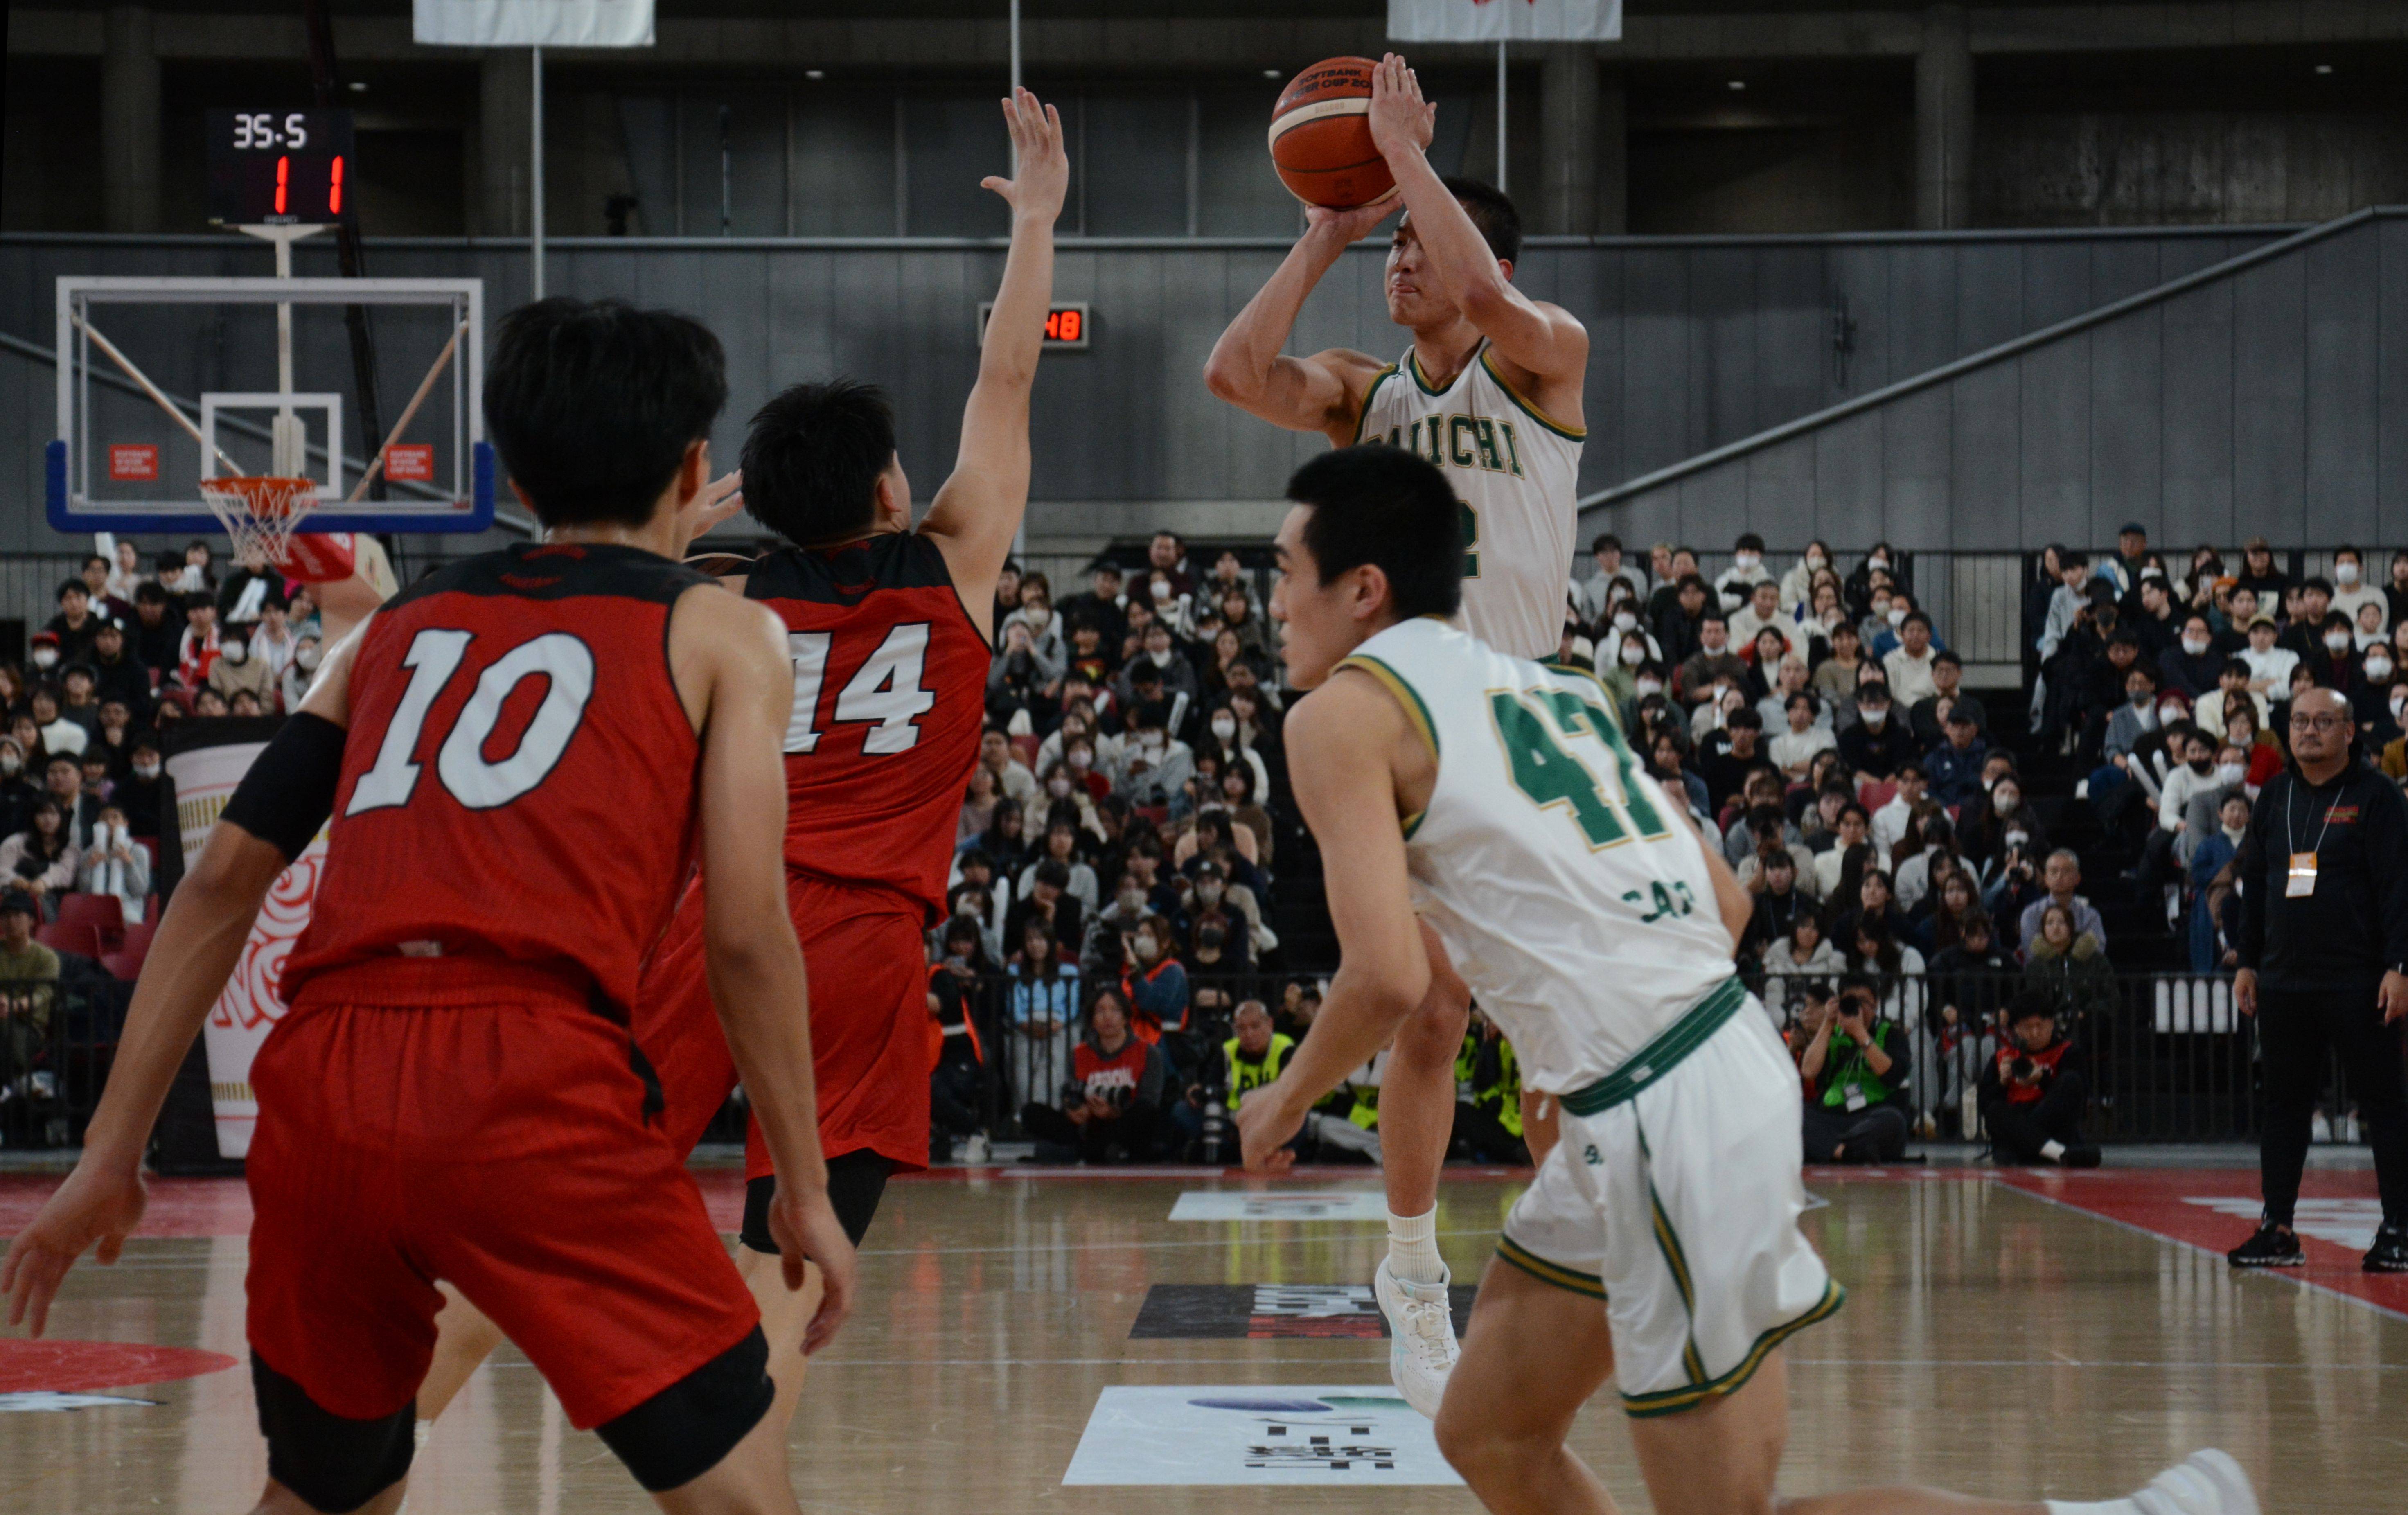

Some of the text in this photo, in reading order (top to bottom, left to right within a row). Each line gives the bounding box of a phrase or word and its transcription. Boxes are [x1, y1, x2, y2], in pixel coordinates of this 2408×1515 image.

[1298, 69, 1361, 86] SOFTBANK
[1322, 78, 1348, 88] CUP
[234, 114, 307, 149] 35.5
[782, 620, 937, 756] 14
[344, 627, 596, 818] 10
